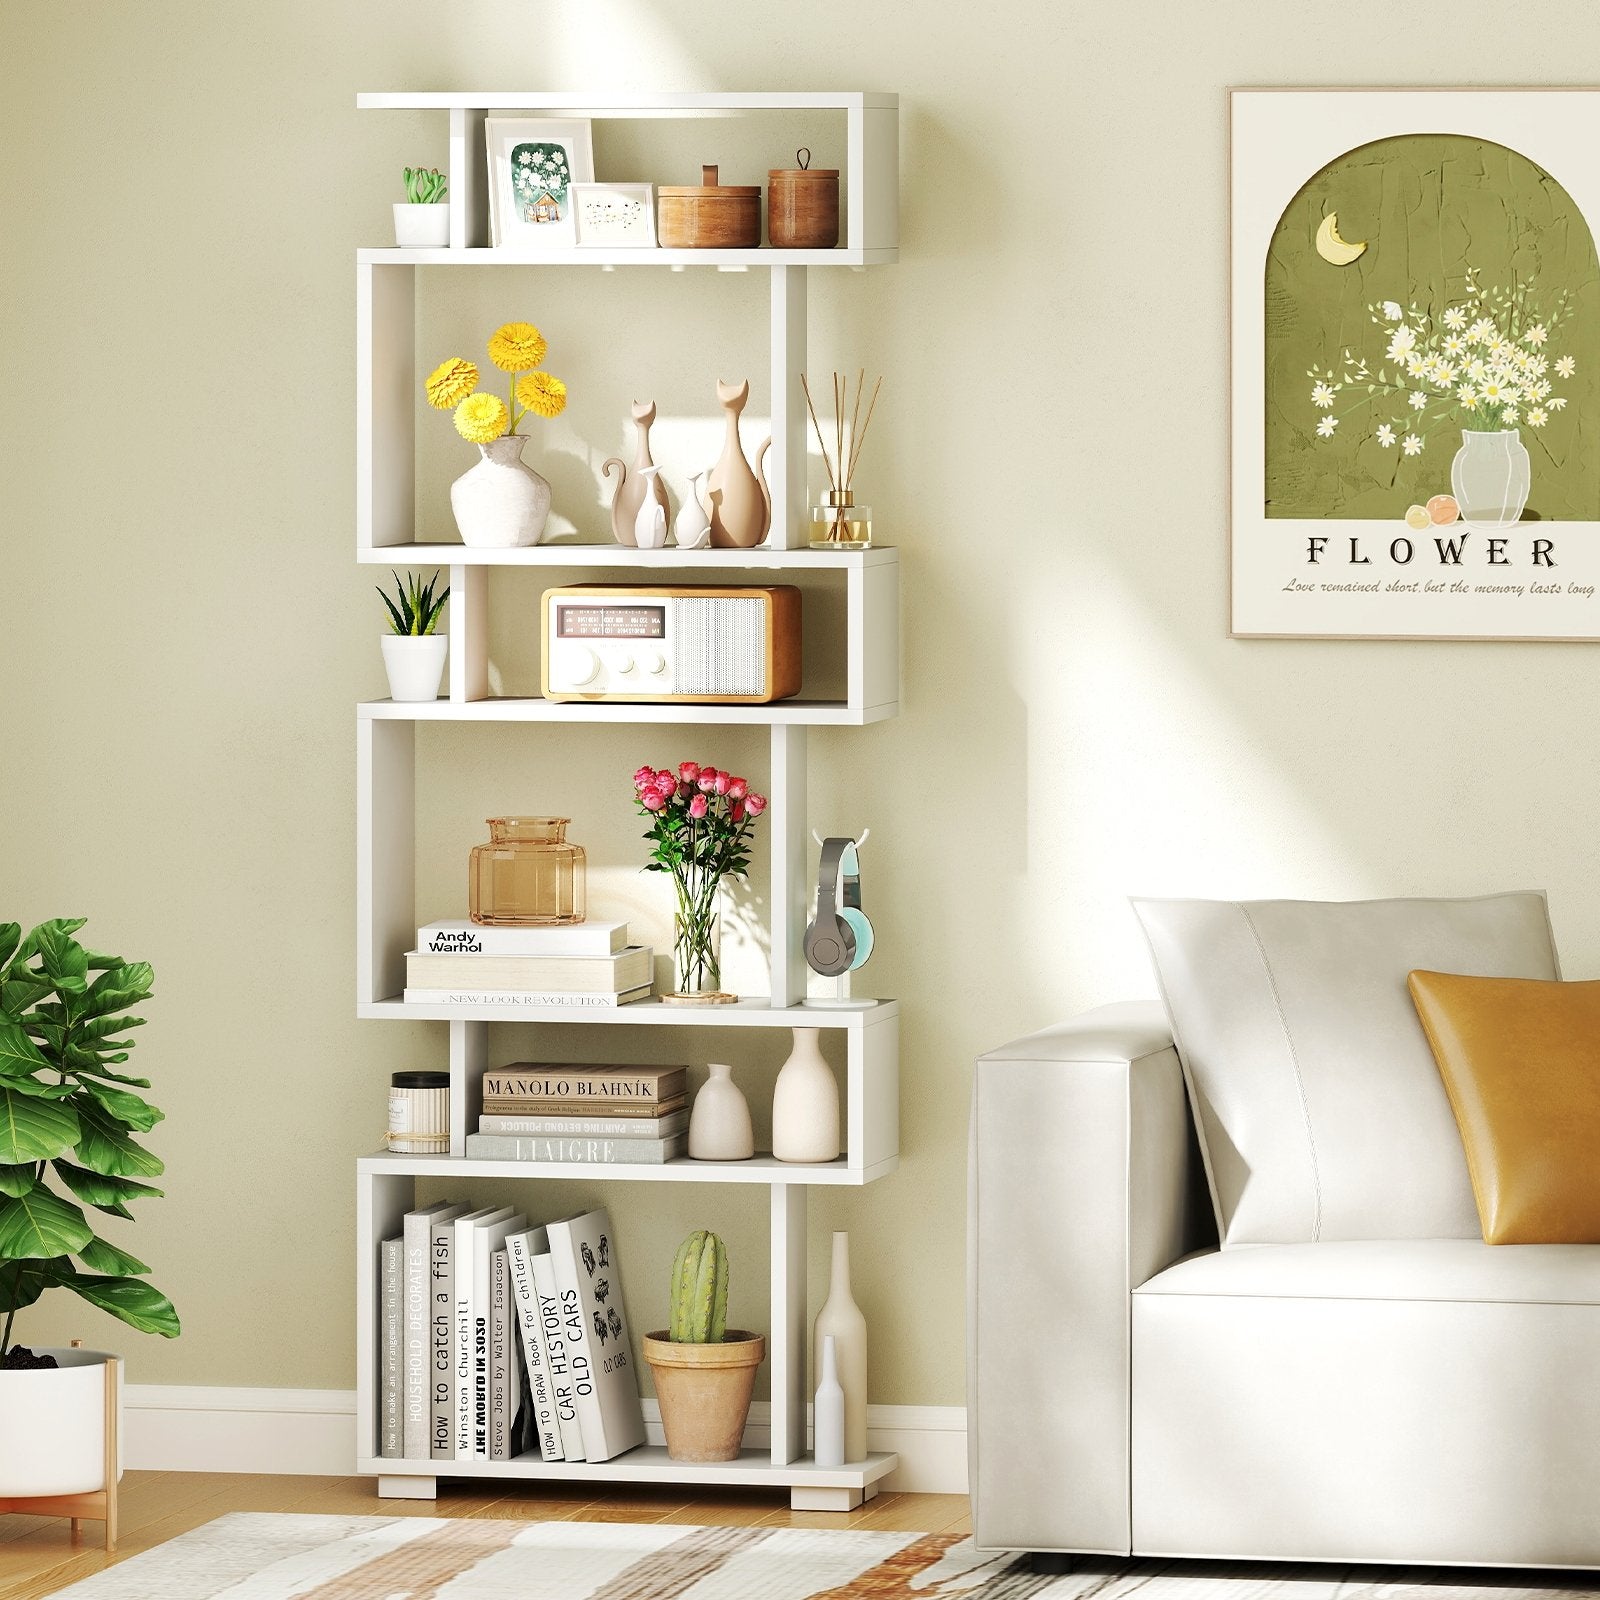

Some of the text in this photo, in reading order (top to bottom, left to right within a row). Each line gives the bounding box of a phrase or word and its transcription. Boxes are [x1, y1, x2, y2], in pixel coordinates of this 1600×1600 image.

[1306, 533, 1558, 569] FLOWER
[1282, 578, 1316, 593] Love
[1321, 581, 1381, 593] remained
[1424, 580, 1447, 593] but
[1450, 580, 1470, 593] the
[1475, 583, 1525, 598] memory
[1530, 581, 1561, 594] lasts
[1568, 582, 1594, 598] long
[429, 943, 482, 953] Warhol
[436, 931, 476, 944] Andy
[449, 995, 610, 1006] NEW LOOK REVOLUTION
[488, 1080, 652, 1096] MANOLO BLAHNÍK
[500, 1121, 541, 1131] POLLOCK
[545, 1122, 582, 1132] BEYOND
[584, 1123, 626, 1133] PAINTING
[516, 1139, 615, 1162] LIAIGRE
[388, 1246, 397, 1450] How to make an arrangement in the house
[409, 1248, 423, 1421] HOUSEHOLD DECORATES
[433, 1237, 448, 1449] How to catch a fish
[514, 1240, 556, 1455] HOW TO DRAW Book for children
[561, 1289, 592, 1396] OLD CARS
[494, 1255, 504, 1455] Steve Jobs by Walter Isaacson
[539, 1294, 575, 1421] CAR HISTORY
[458, 1298, 468, 1449] Winston Churchill
